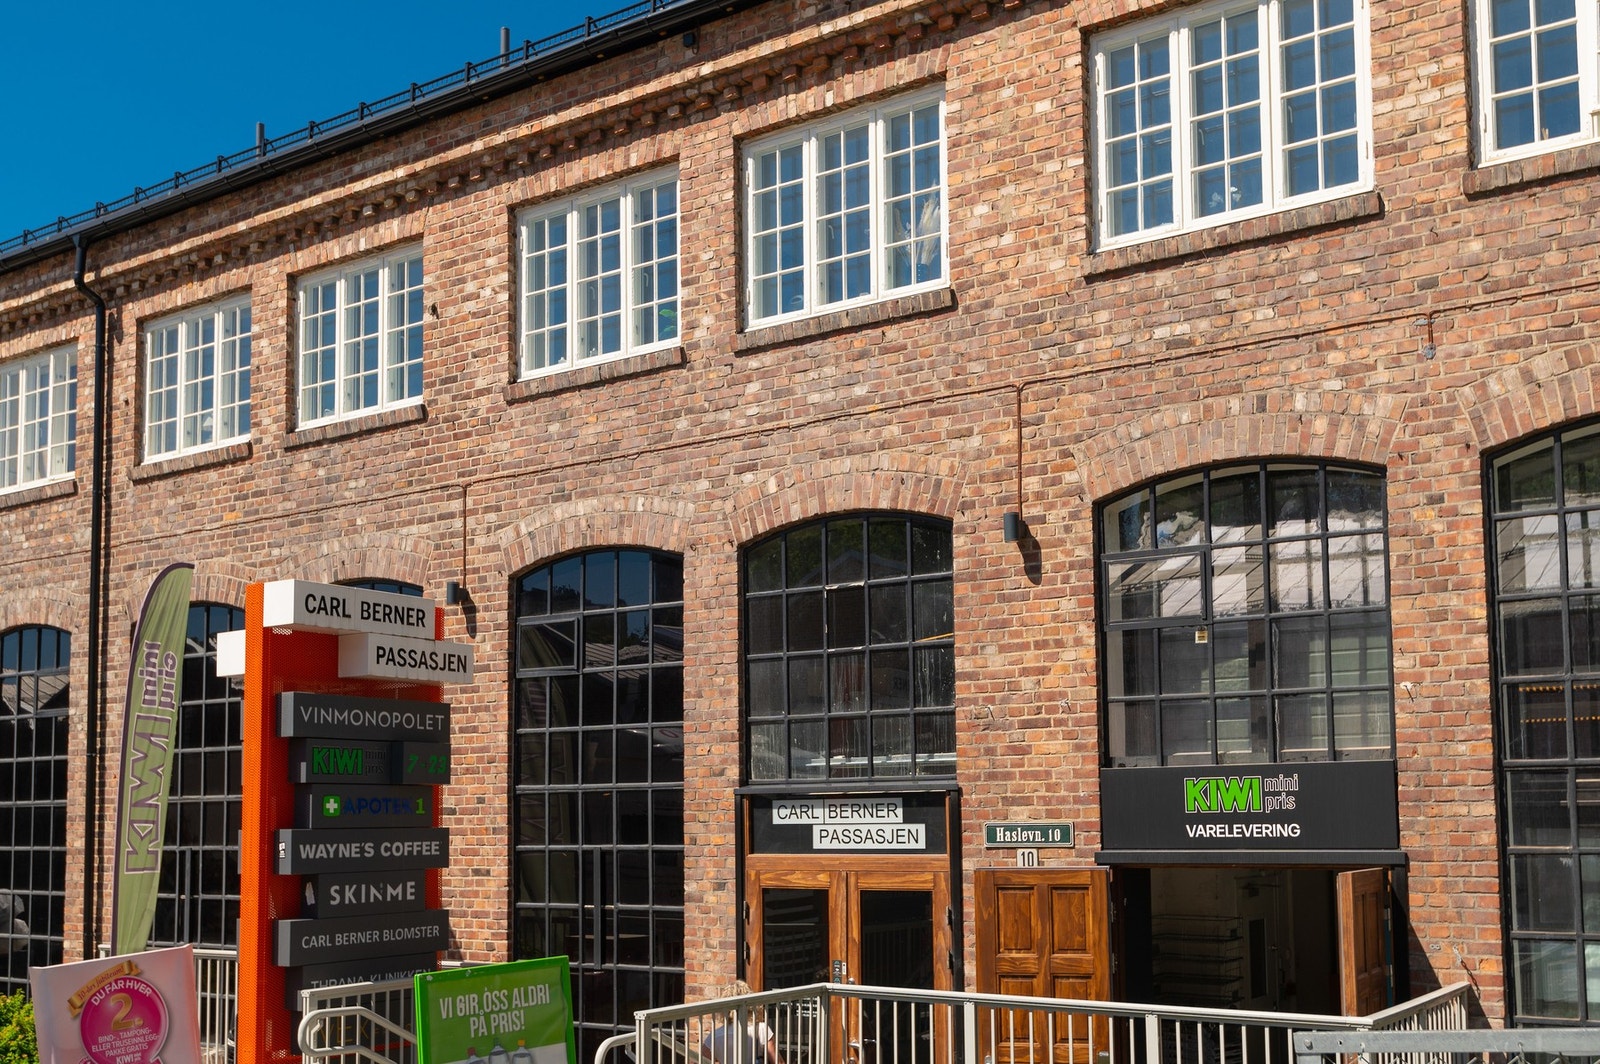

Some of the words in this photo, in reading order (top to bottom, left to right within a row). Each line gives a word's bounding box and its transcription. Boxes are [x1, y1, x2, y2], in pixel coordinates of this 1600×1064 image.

[304, 593, 352, 619] CARL
[360, 601, 426, 628] BERNER
[375, 645, 468, 673] PASSASJEN
[138, 640, 161, 707] mini
[300, 705, 445, 731] VINMONOPOLET
[312, 746, 364, 775] KIWI
[125, 713, 172, 874] KIWI
[1184, 775, 1263, 813] KIWI
[1264, 773, 1299, 792] mini
[1265, 791, 1296, 813] pris
[343, 797, 412, 815] APOTEK
[416, 798, 425, 814] 1
[777, 803, 820, 821] CARL
[828, 802, 899, 819] BERNER
[818, 828, 919, 846] PASSASJEN
[996, 827, 1045, 842] Haslevn.
[1048, 828, 1061, 842] 10
[1186, 823, 1301, 839] VARELEVERING
[299, 842, 375, 859] WAYNE'S
[380, 841, 440, 857] COFFEE
[1020, 851, 1034, 867] 10
[302, 935, 332, 949] CARL
[335, 930, 379, 945] BERNER
[382, 925, 440, 942] BLOMSTER
[370, 968, 431, 982] KLINIKK
[91, 991, 106, 1006] DU
[126, 979, 153, 997] HVER
[439, 997, 453, 1019] VI
[456, 993, 480, 1017] GIR
[512, 983, 550, 1009] ALDRI
[110, 992, 144, 1031] 2.
[469, 1009, 488, 1038] PÅ
[490, 1009, 525, 1035] PRIS!
[92, 1043, 111, 1052] ELLER
[105, 1047, 126, 1057] PAKKE
[126, 1043, 149, 1053] GRATIS
[116, 1054, 134, 1064] KIWI
